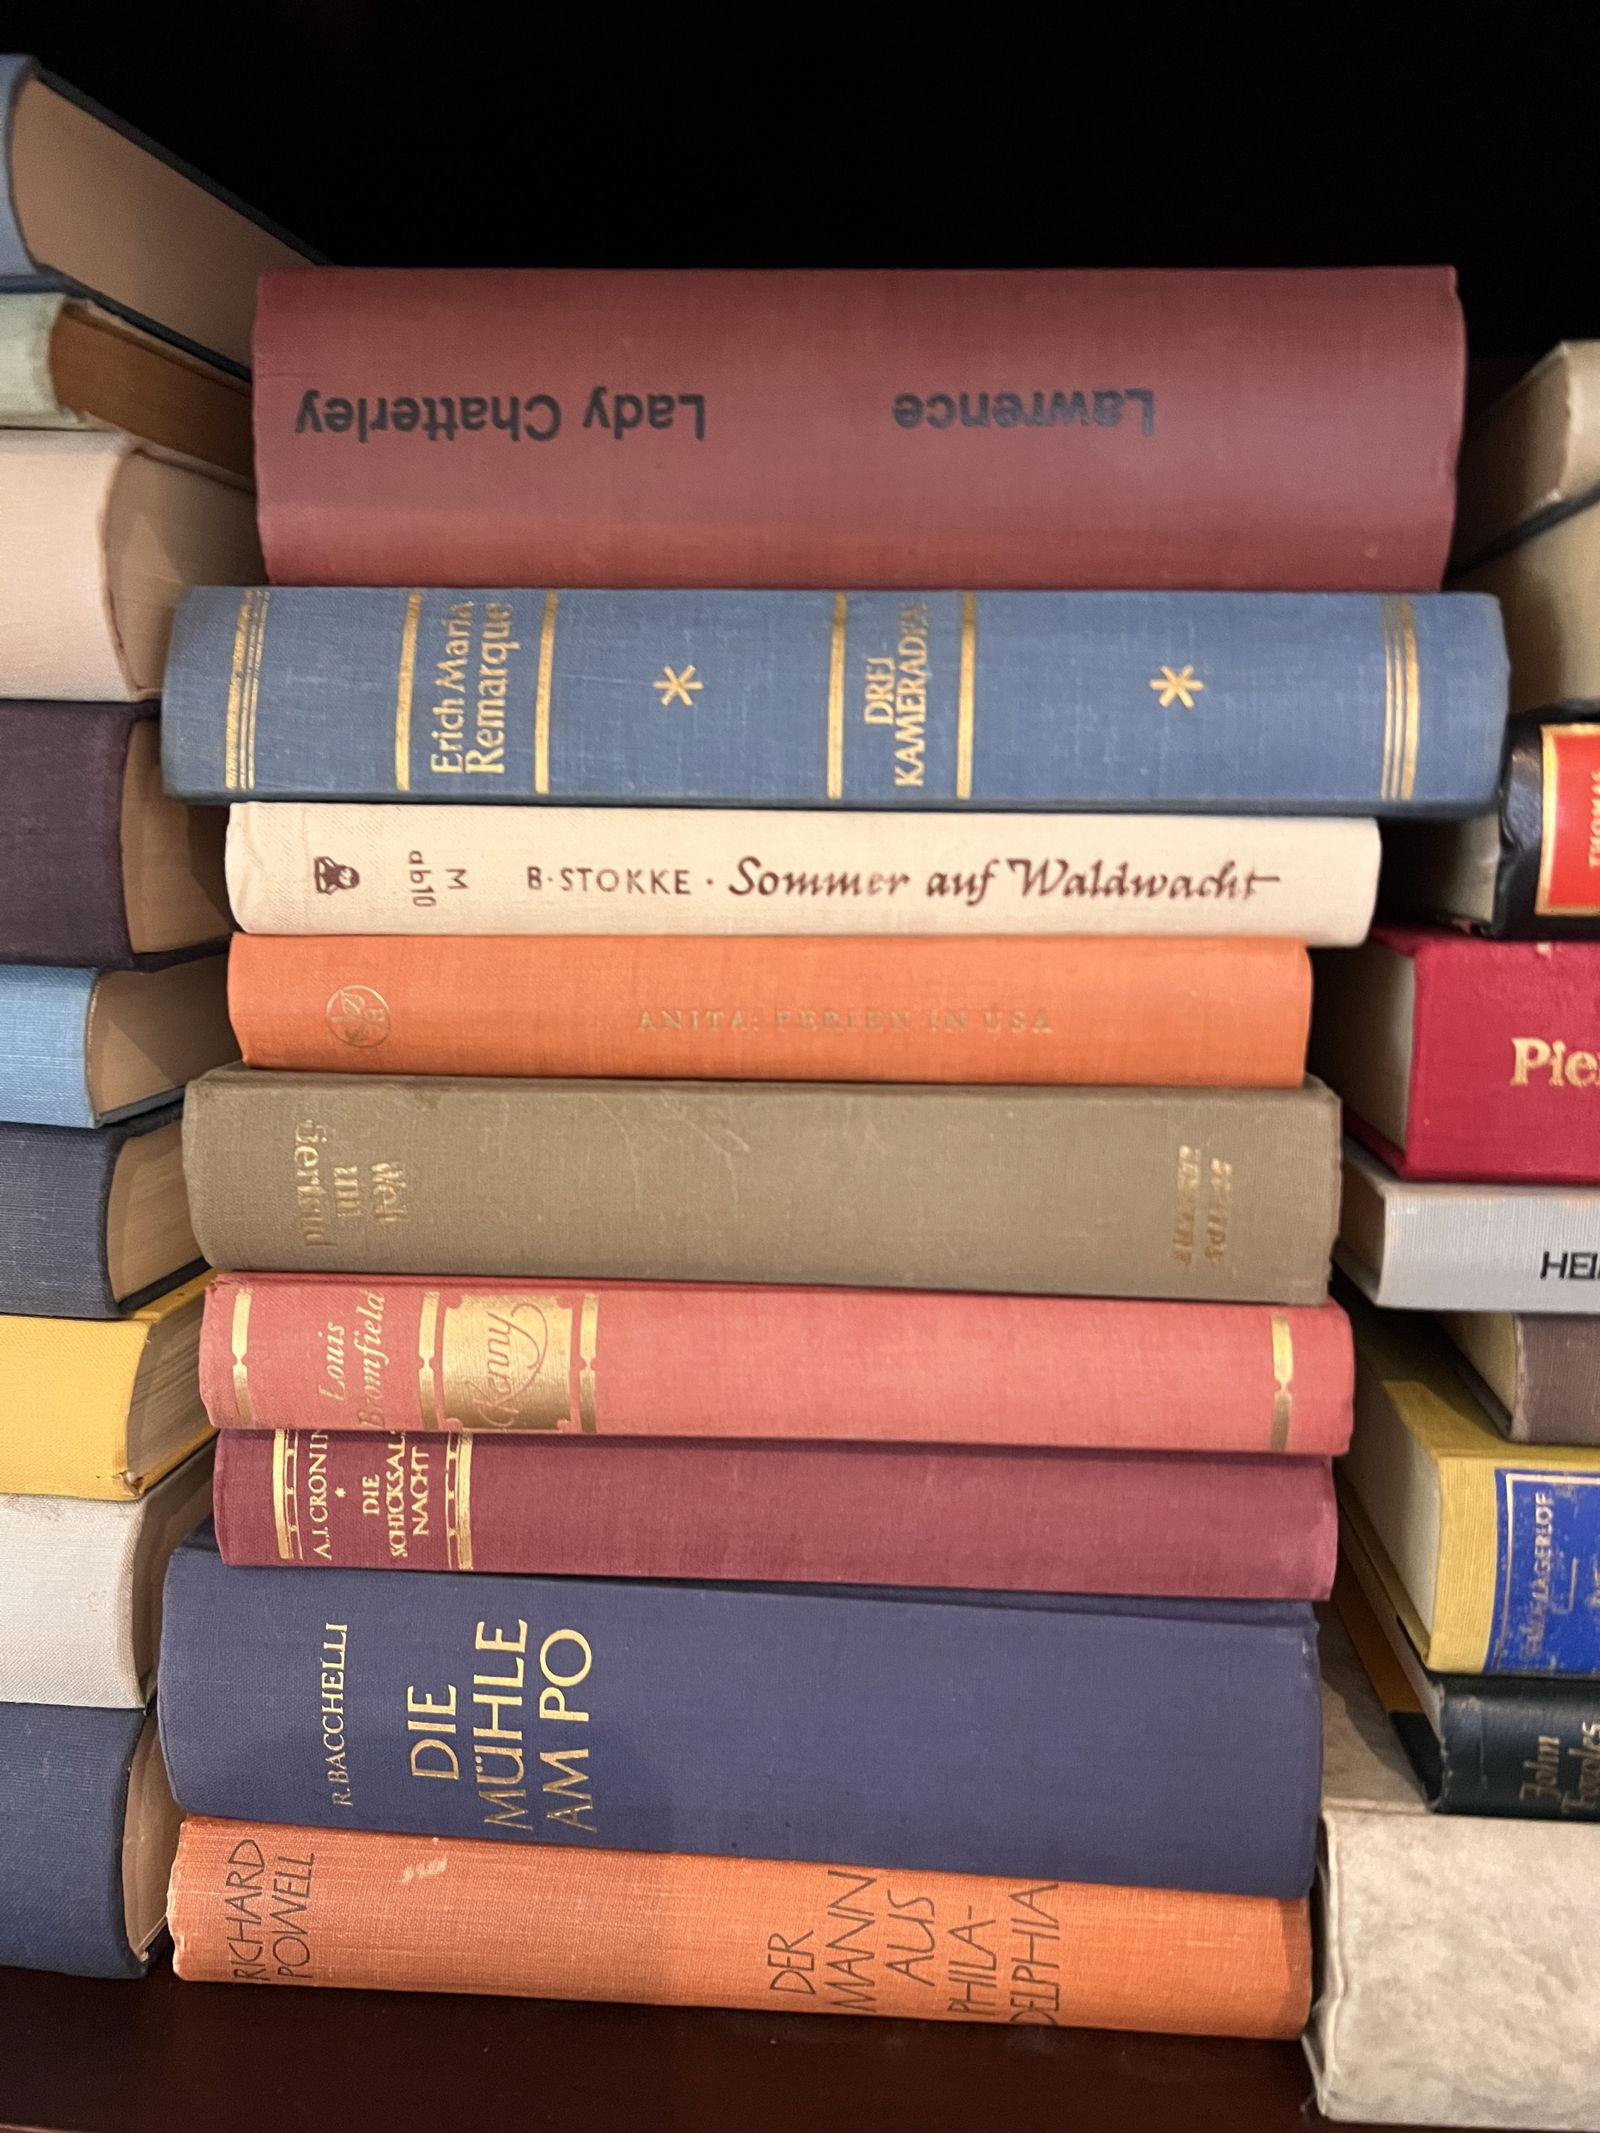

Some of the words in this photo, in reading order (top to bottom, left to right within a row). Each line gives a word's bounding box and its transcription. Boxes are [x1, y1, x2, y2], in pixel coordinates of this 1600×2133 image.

[295, 388, 562, 442] Chatterley
[583, 385, 707, 441] Lady
[892, 387, 1156, 437] Lawrence
[434, 600, 475, 693] Maria
[465, 603, 521, 774] Remarque
[430, 698, 465, 774] Erich
[728, 856, 910, 896] Sommer
[926, 858, 999, 905] auf
[1007, 857, 1282, 900] Waldwacht
[637, 1009, 760, 1033] ANITA:
[774, 1010, 912, 1033] FERIEN
[929, 1010, 968, 1033] IN
[982, 1010, 1055, 1034] USA
[1509, 1037, 1600, 1089] Pie
[1540, 1250, 1600, 1280] HEI
[318, 1320, 345, 1401] Louis
[353, 1286, 390, 1429] Bromfield
[362, 1473, 380, 1515] DIE
[386, 1430, 408, 1557] SCHICKSAL
[410, 1445, 430, 1536] NACHT
[539, 1628, 592, 1722] PO
[407, 1683, 460, 1780] DIE
[472, 1618, 533, 1831] MÜHLE
[539, 1748, 597, 1832] AM
[225, 1838, 271, 1982] RICHARD
[269, 1852, 315, 1979] POWELL
[824, 1869, 878, 2014] MANN
[883, 1888, 936, 1987] AUS
[767, 1929, 817, 1995] DER
[947, 1904, 998, 2016] PHILA-
